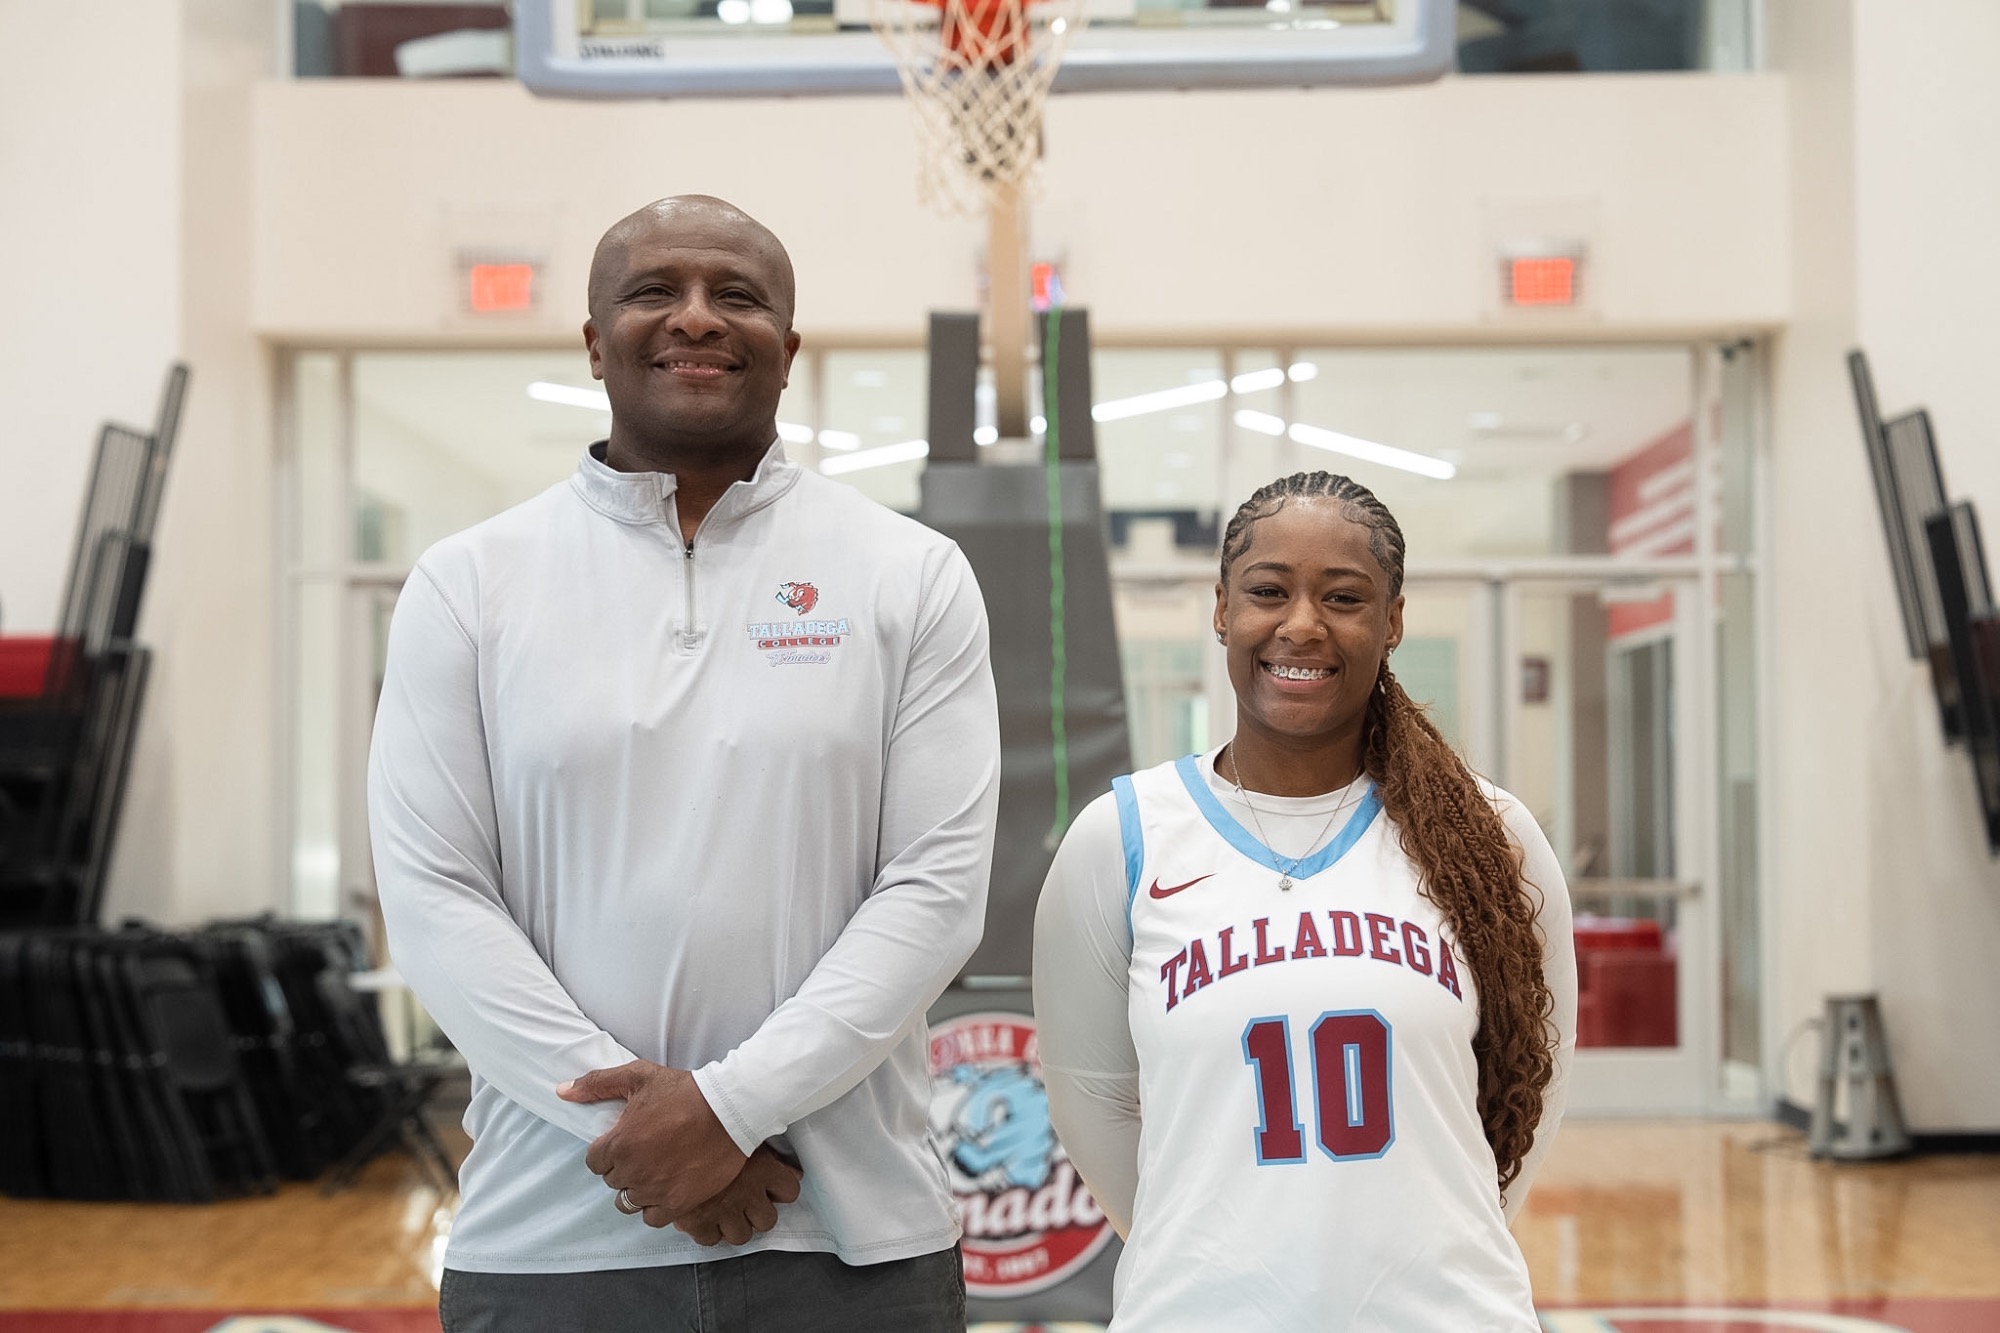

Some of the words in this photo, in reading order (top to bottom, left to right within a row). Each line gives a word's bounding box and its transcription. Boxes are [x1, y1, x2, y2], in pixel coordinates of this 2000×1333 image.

[747, 618, 850, 640] TALLADEGA
[759, 637, 841, 648] COLLEGE
[1160, 910, 1463, 1015] TALLADEGA
[1240, 1008, 1396, 1167] 10
